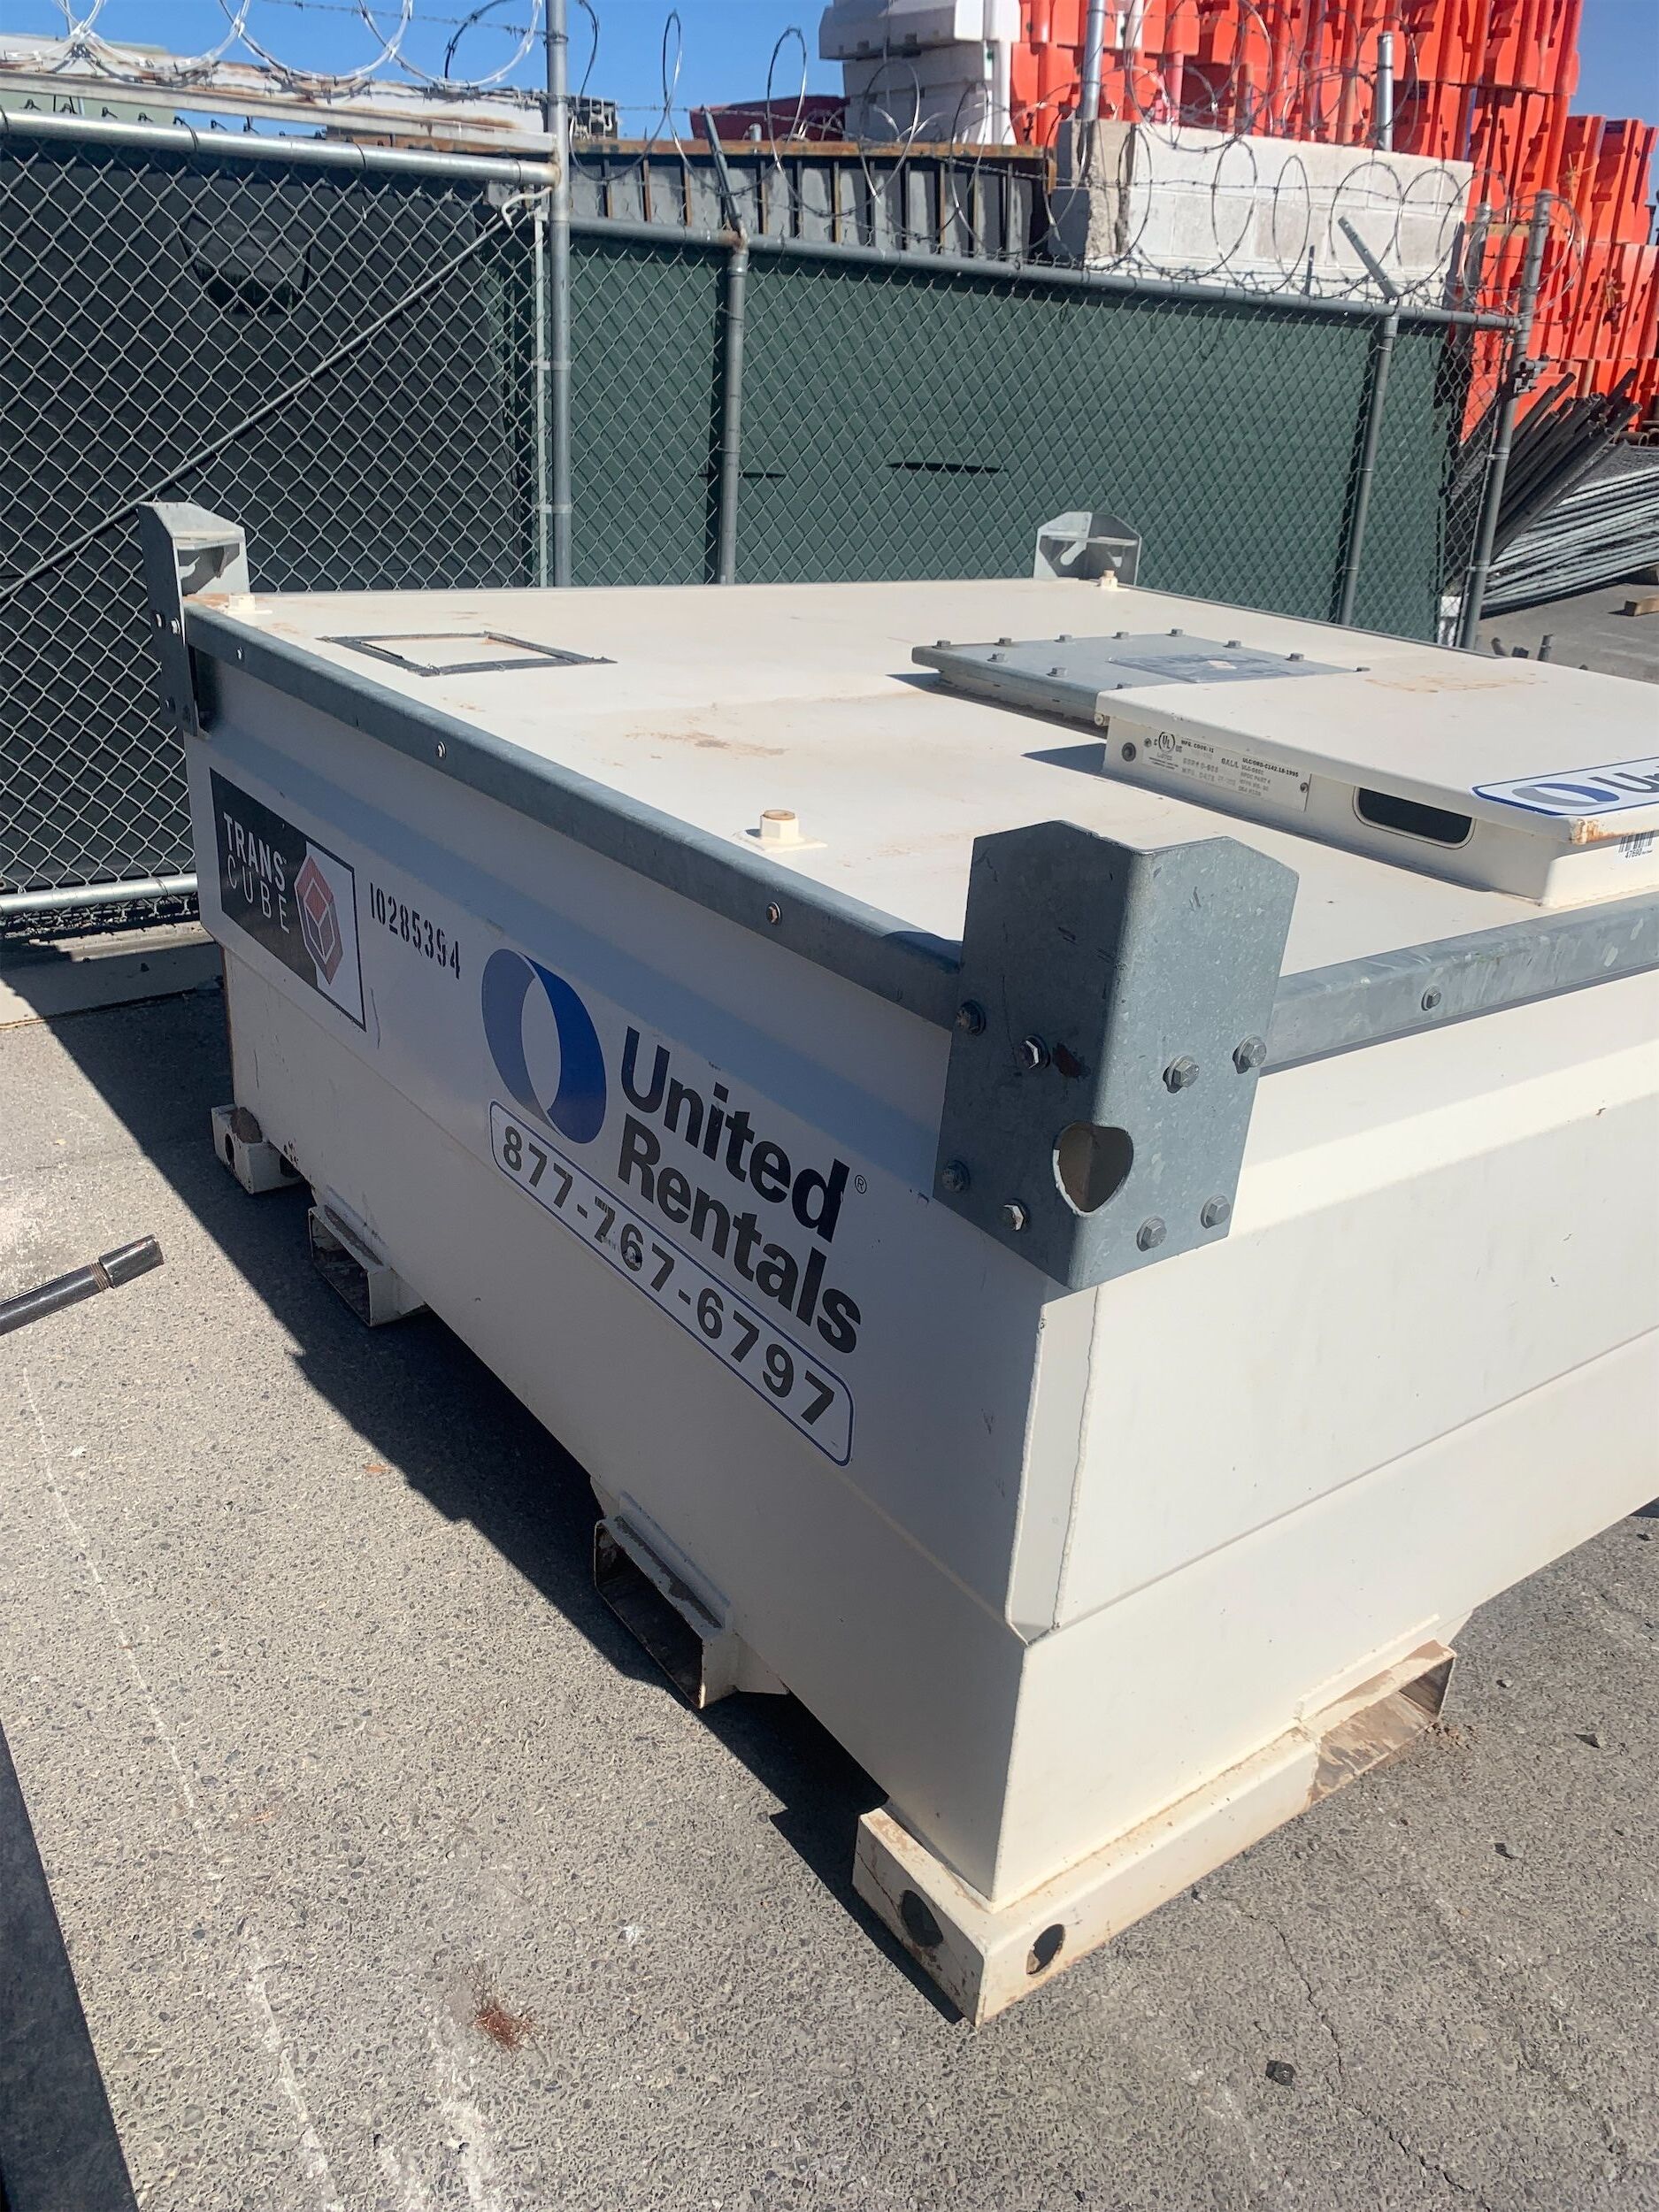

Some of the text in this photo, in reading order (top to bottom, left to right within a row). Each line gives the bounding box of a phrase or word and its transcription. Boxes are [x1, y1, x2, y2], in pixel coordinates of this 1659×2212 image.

[223, 811, 286, 892] TRANS
[227, 854, 290, 933] CUBE
[370, 881, 461, 979] 10285394
[620, 1025, 850, 1242] United
[502, 1125, 835, 1426] 877-767-6797
[617, 1113, 862, 1355] Rentals
